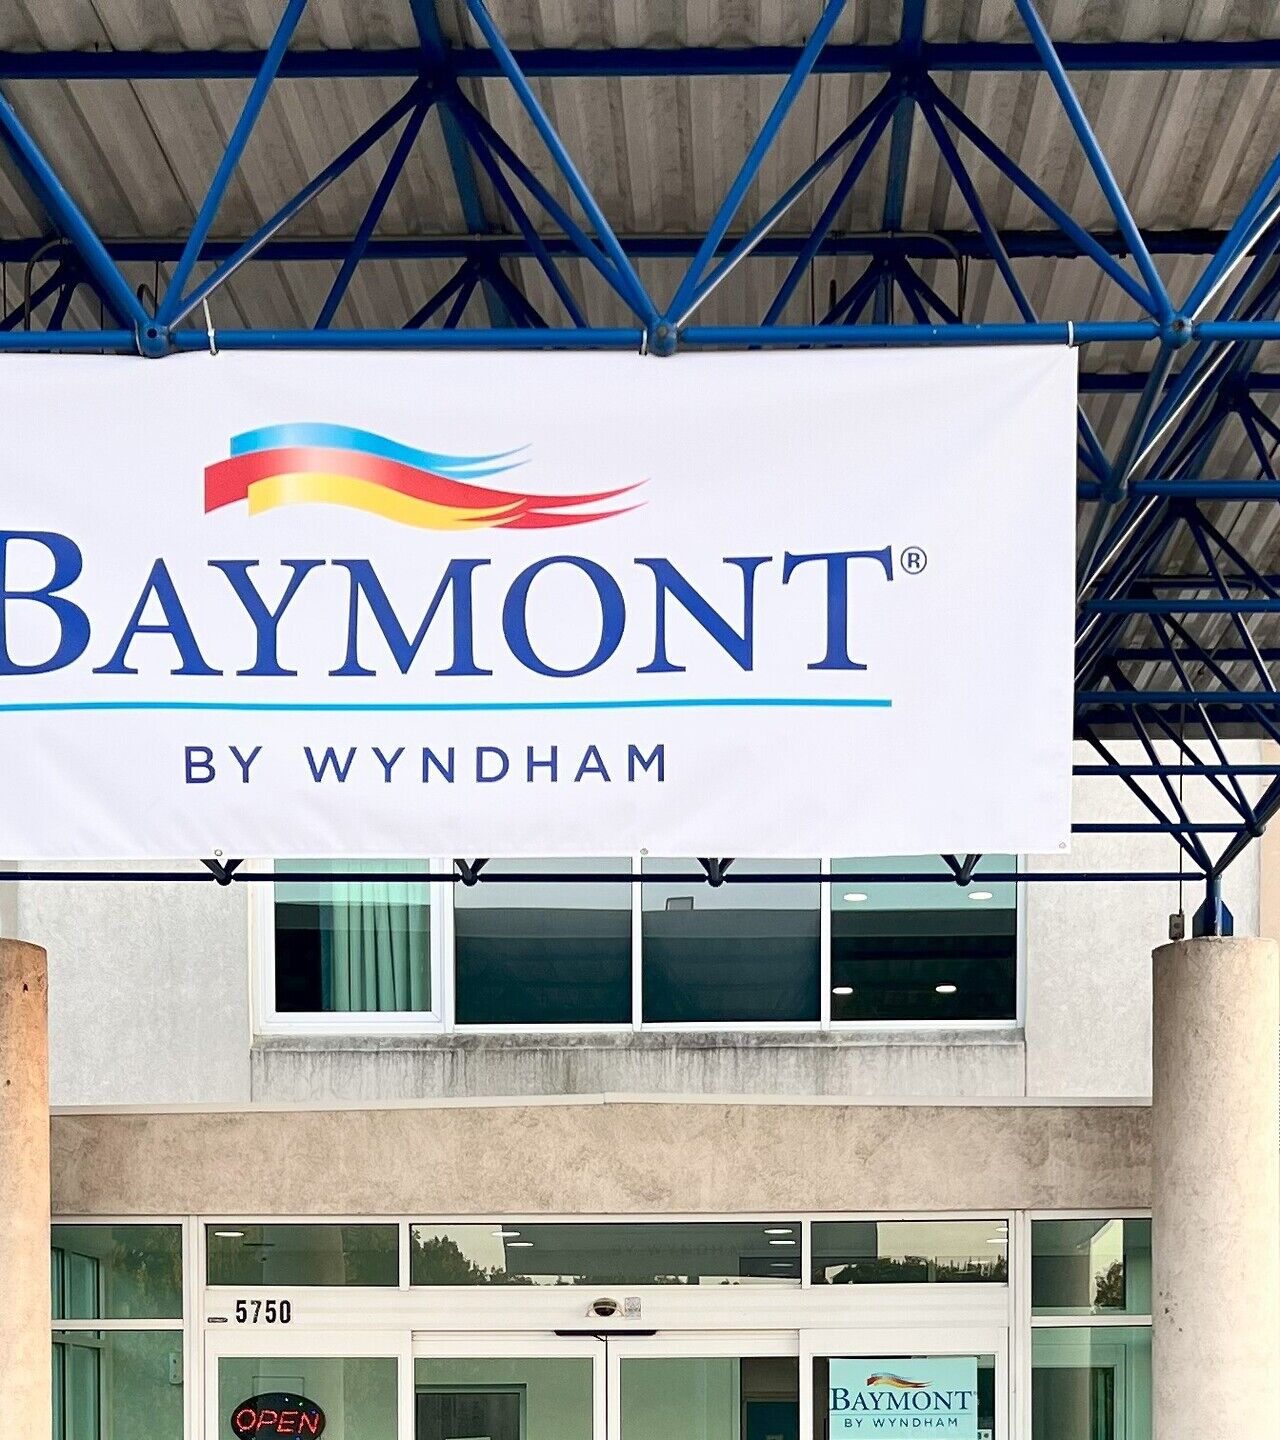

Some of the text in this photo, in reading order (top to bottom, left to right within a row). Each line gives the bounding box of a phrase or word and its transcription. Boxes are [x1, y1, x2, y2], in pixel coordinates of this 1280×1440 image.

[185, 744, 665, 784] BY WYNDHAM
[236, 1300, 291, 1323] 5750
[830, 1388, 973, 1411] BAYMONT
[236, 1408, 320, 1434] OPEN
[844, 1417, 958, 1428] BY WYNDHAM
